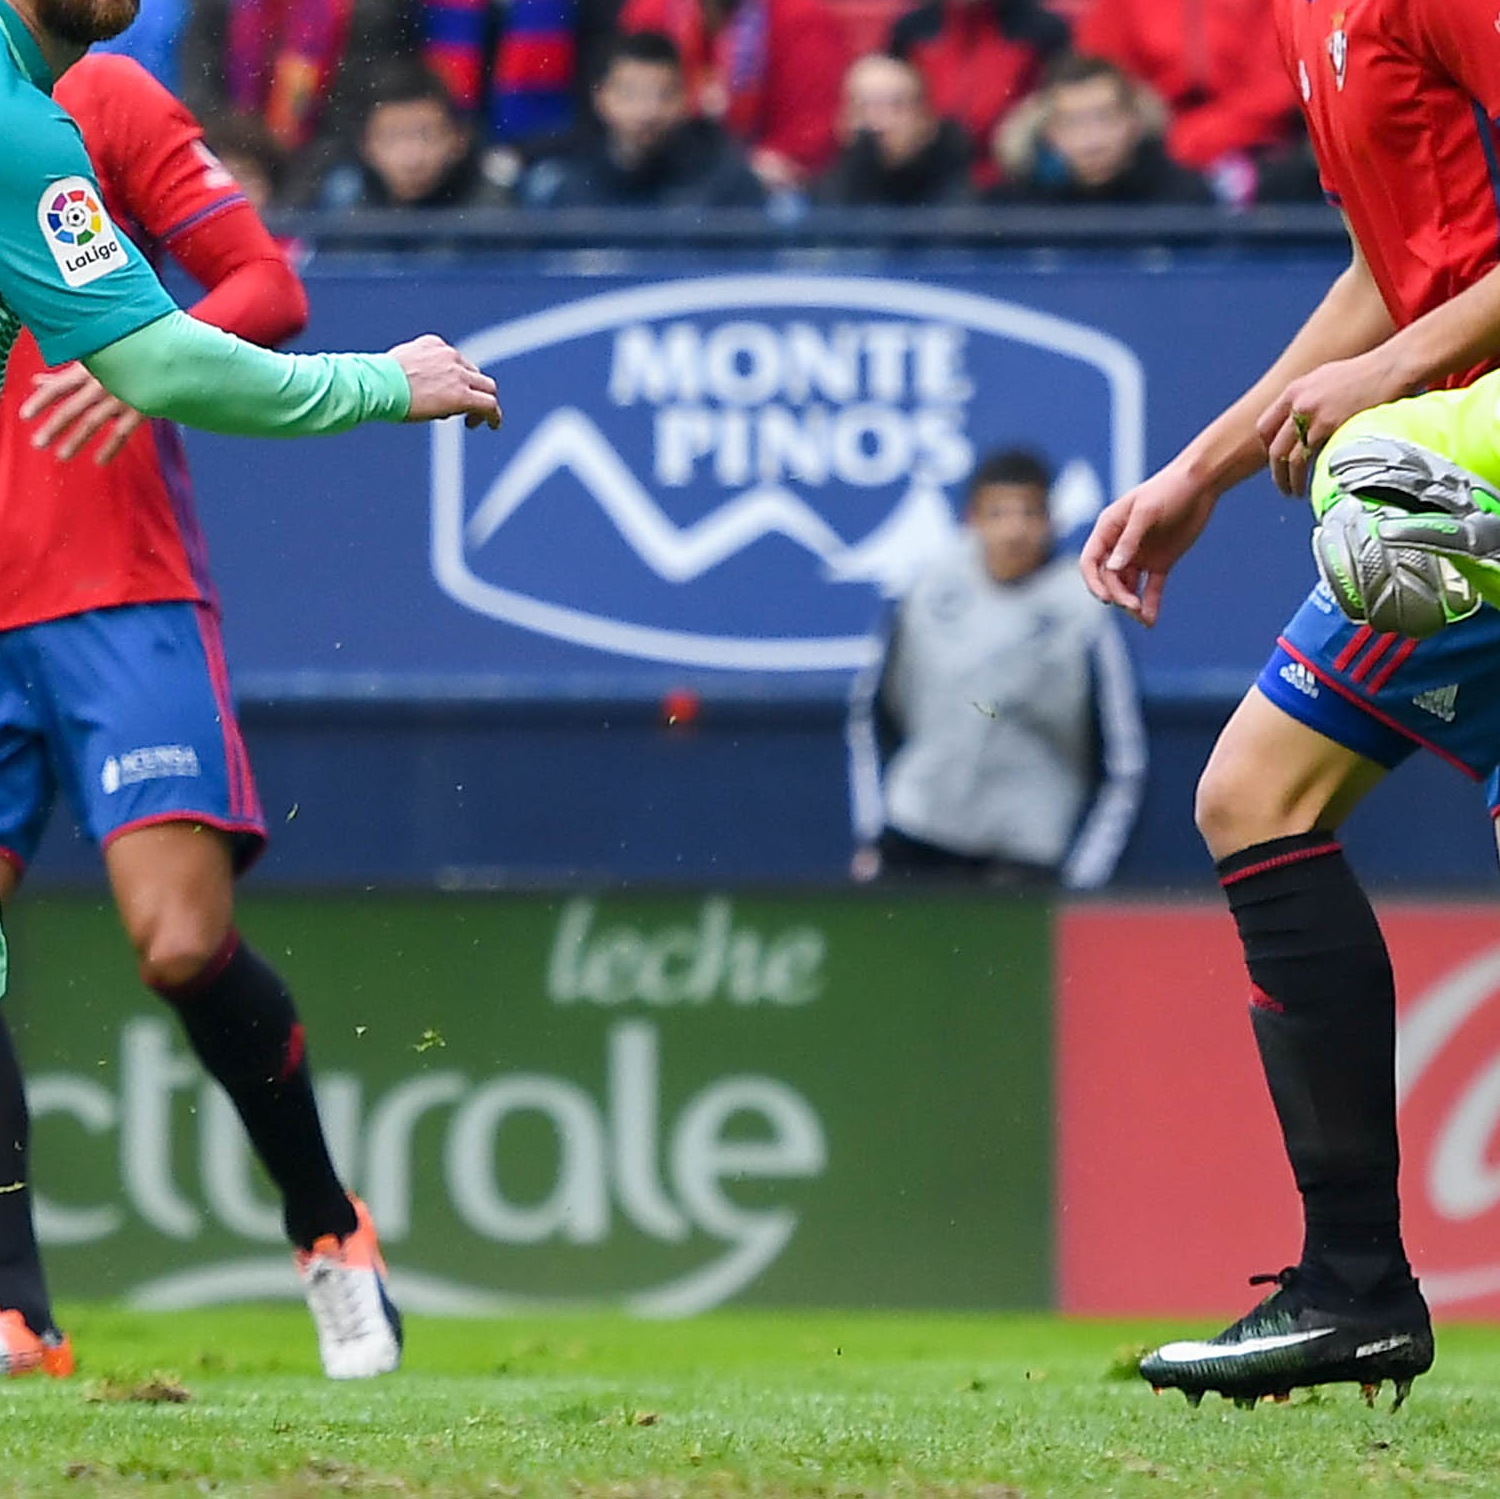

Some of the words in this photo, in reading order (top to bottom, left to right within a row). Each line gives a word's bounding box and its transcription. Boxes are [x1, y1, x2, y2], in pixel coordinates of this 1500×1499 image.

[65, 241, 118, 272] LaLiga
[608, 322, 975, 406] MONTE
[652, 400, 975, 488] PINOS
[548, 896, 826, 1005] leche
